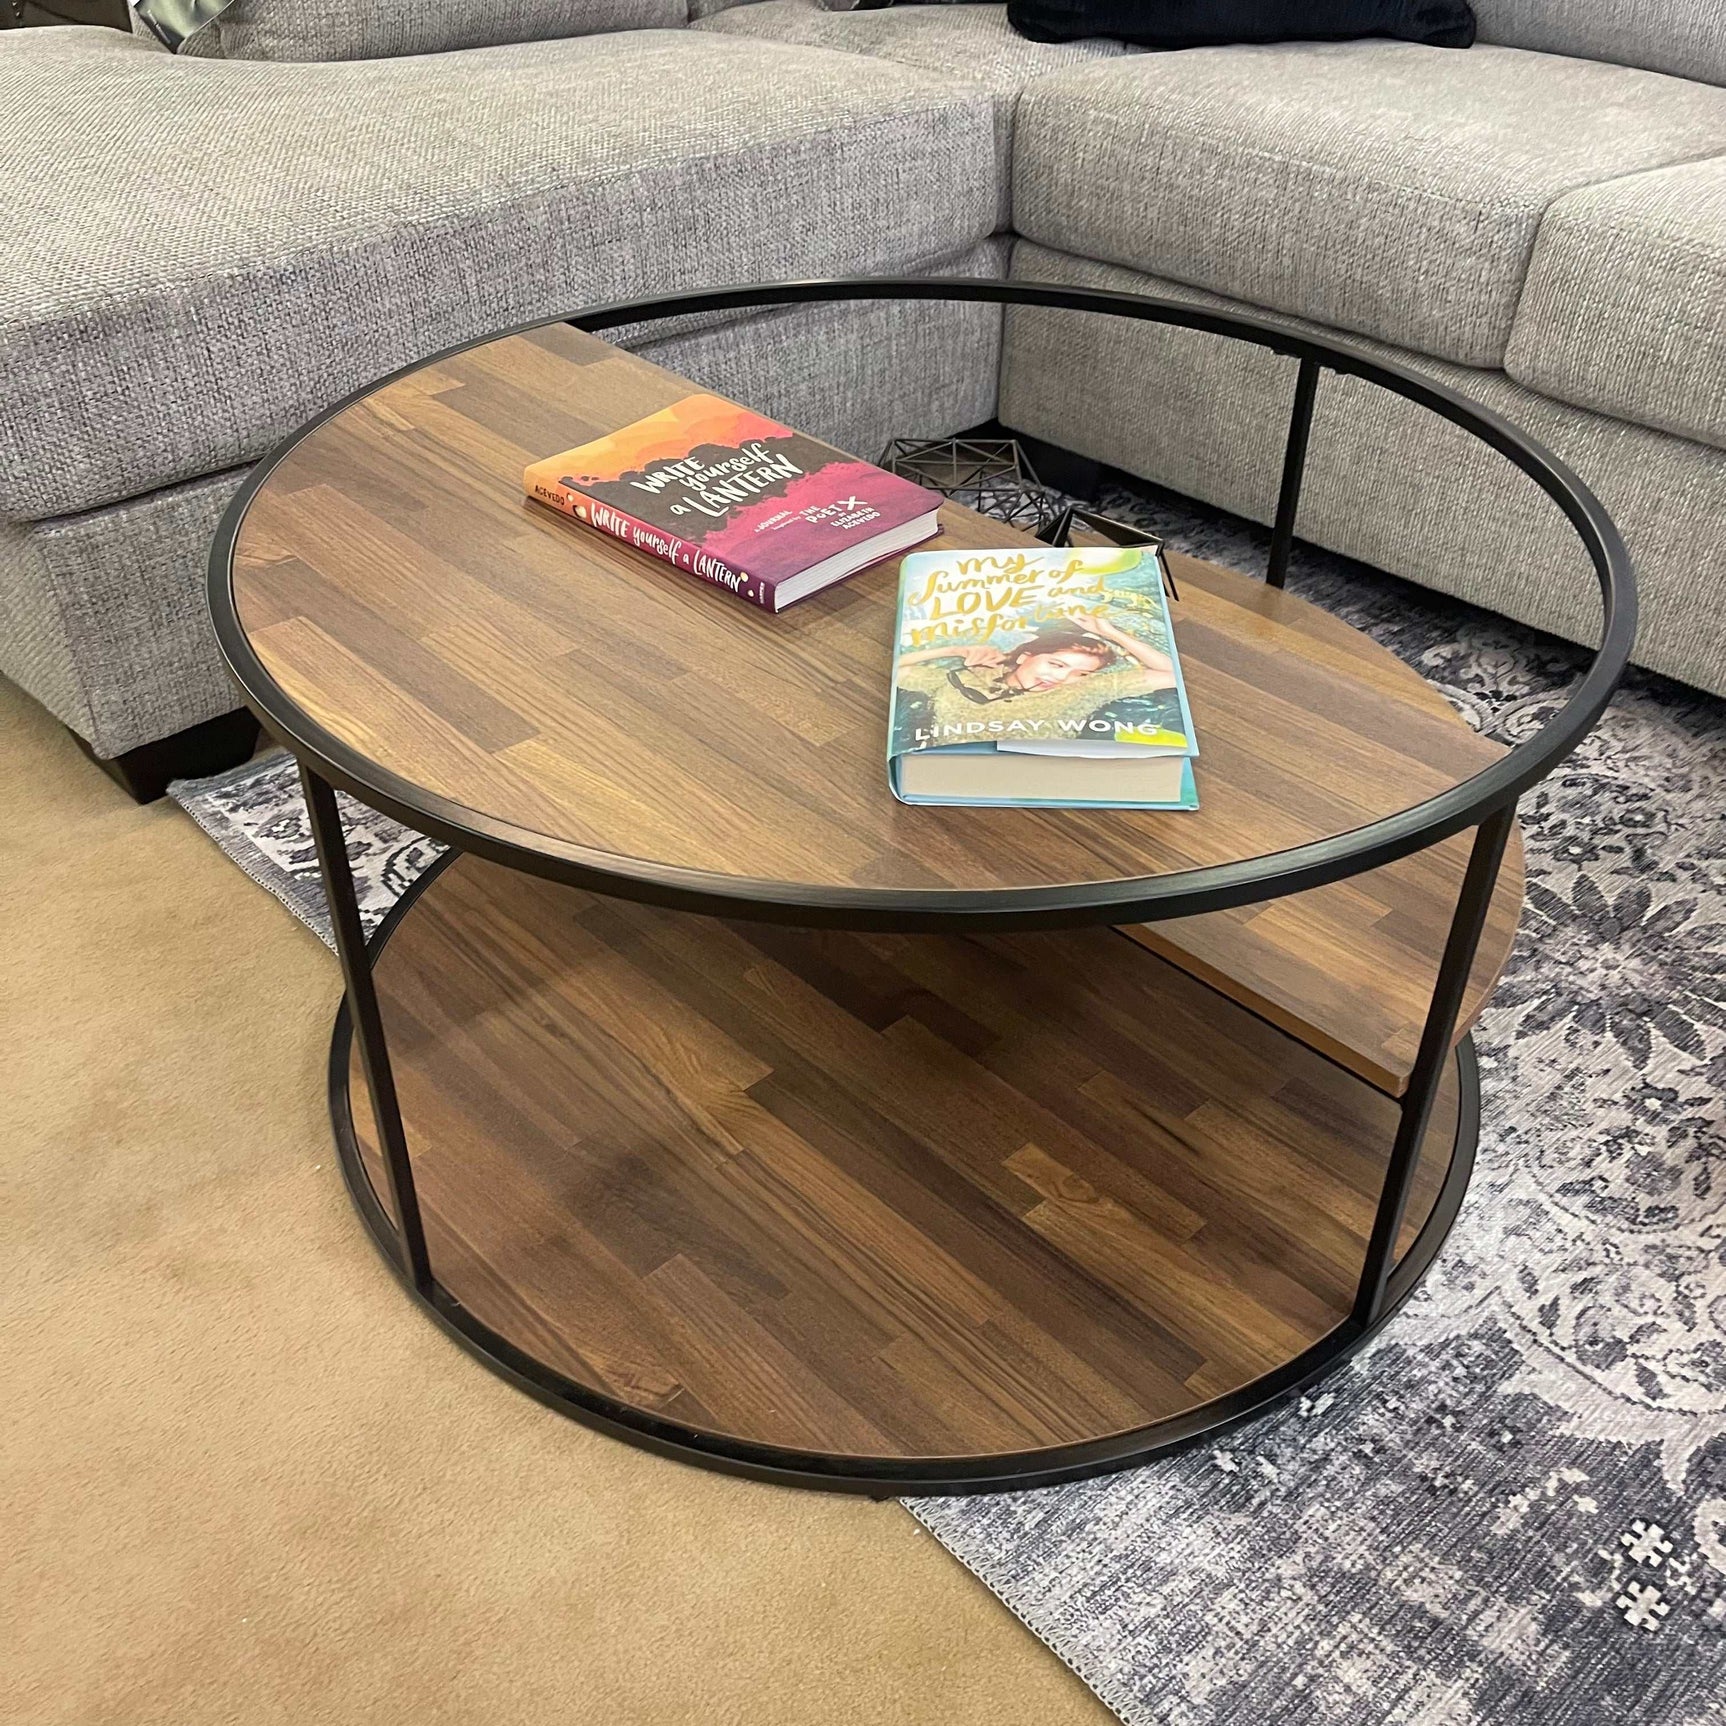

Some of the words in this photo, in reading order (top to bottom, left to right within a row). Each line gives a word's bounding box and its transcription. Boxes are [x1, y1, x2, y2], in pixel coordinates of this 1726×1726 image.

[630, 456, 705, 494] WRITE
[679, 443, 774, 491] yourself
[535, 485, 565, 505] ACEVEDO
[670, 504, 691, 515] a
[682, 453, 803, 517] LANTERN
[800, 505, 821, 516] THE
[805, 504, 842, 523] POET
[837, 495, 868, 511] X
[842, 511, 881, 530] ACEVEDO
[591, 502, 630, 537] WRITE
[633, 527, 682, 566] yourself
[683, 553, 690, 564] a
[693, 550, 741, 592] LANTERN
[1048, 559, 1083, 584] of
[930, 585, 1046, 622] LOVE
[1048, 577, 1105, 597] and
[915, 719, 1046, 742] LINDSAY
[1057, 719, 1159, 736] WONG
